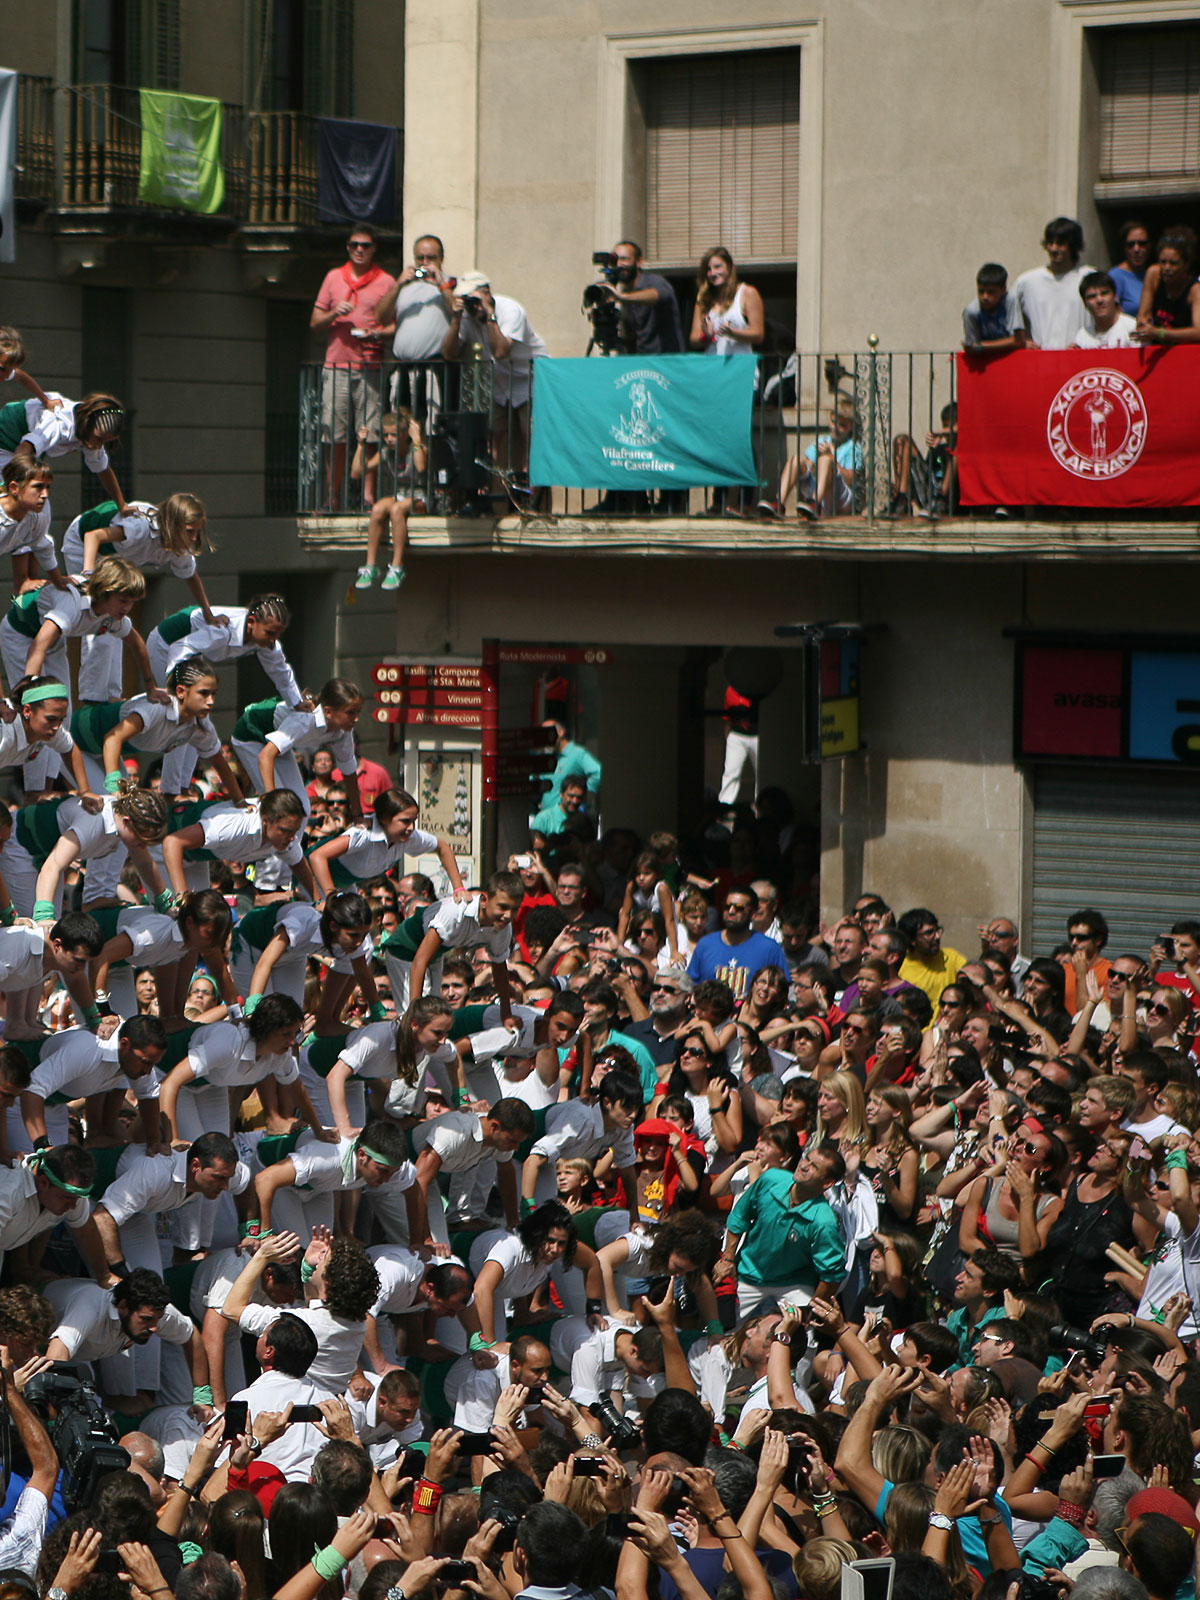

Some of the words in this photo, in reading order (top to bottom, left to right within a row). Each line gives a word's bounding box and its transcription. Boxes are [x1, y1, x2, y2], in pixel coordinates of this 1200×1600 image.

[1052, 374, 1125, 417] XICOTS
[1122, 388, 1141, 415] DE
[601, 447, 654, 460] Vilafranca
[1050, 420, 1146, 476] VILAFRANCA
[624, 460, 676, 471] Castellers
[499, 650, 518, 662] Ruta
[520, 650, 567, 662] Modernista
[439, 667, 480, 679] Campanar
[428, 677, 438, 687] de
[440, 677, 455, 687] Sta.
[457, 677, 481, 687] Maria
[447, 694, 482, 705] Vinseum
[416, 712, 439, 723] Altres
[440, 712, 480, 724] direccions
